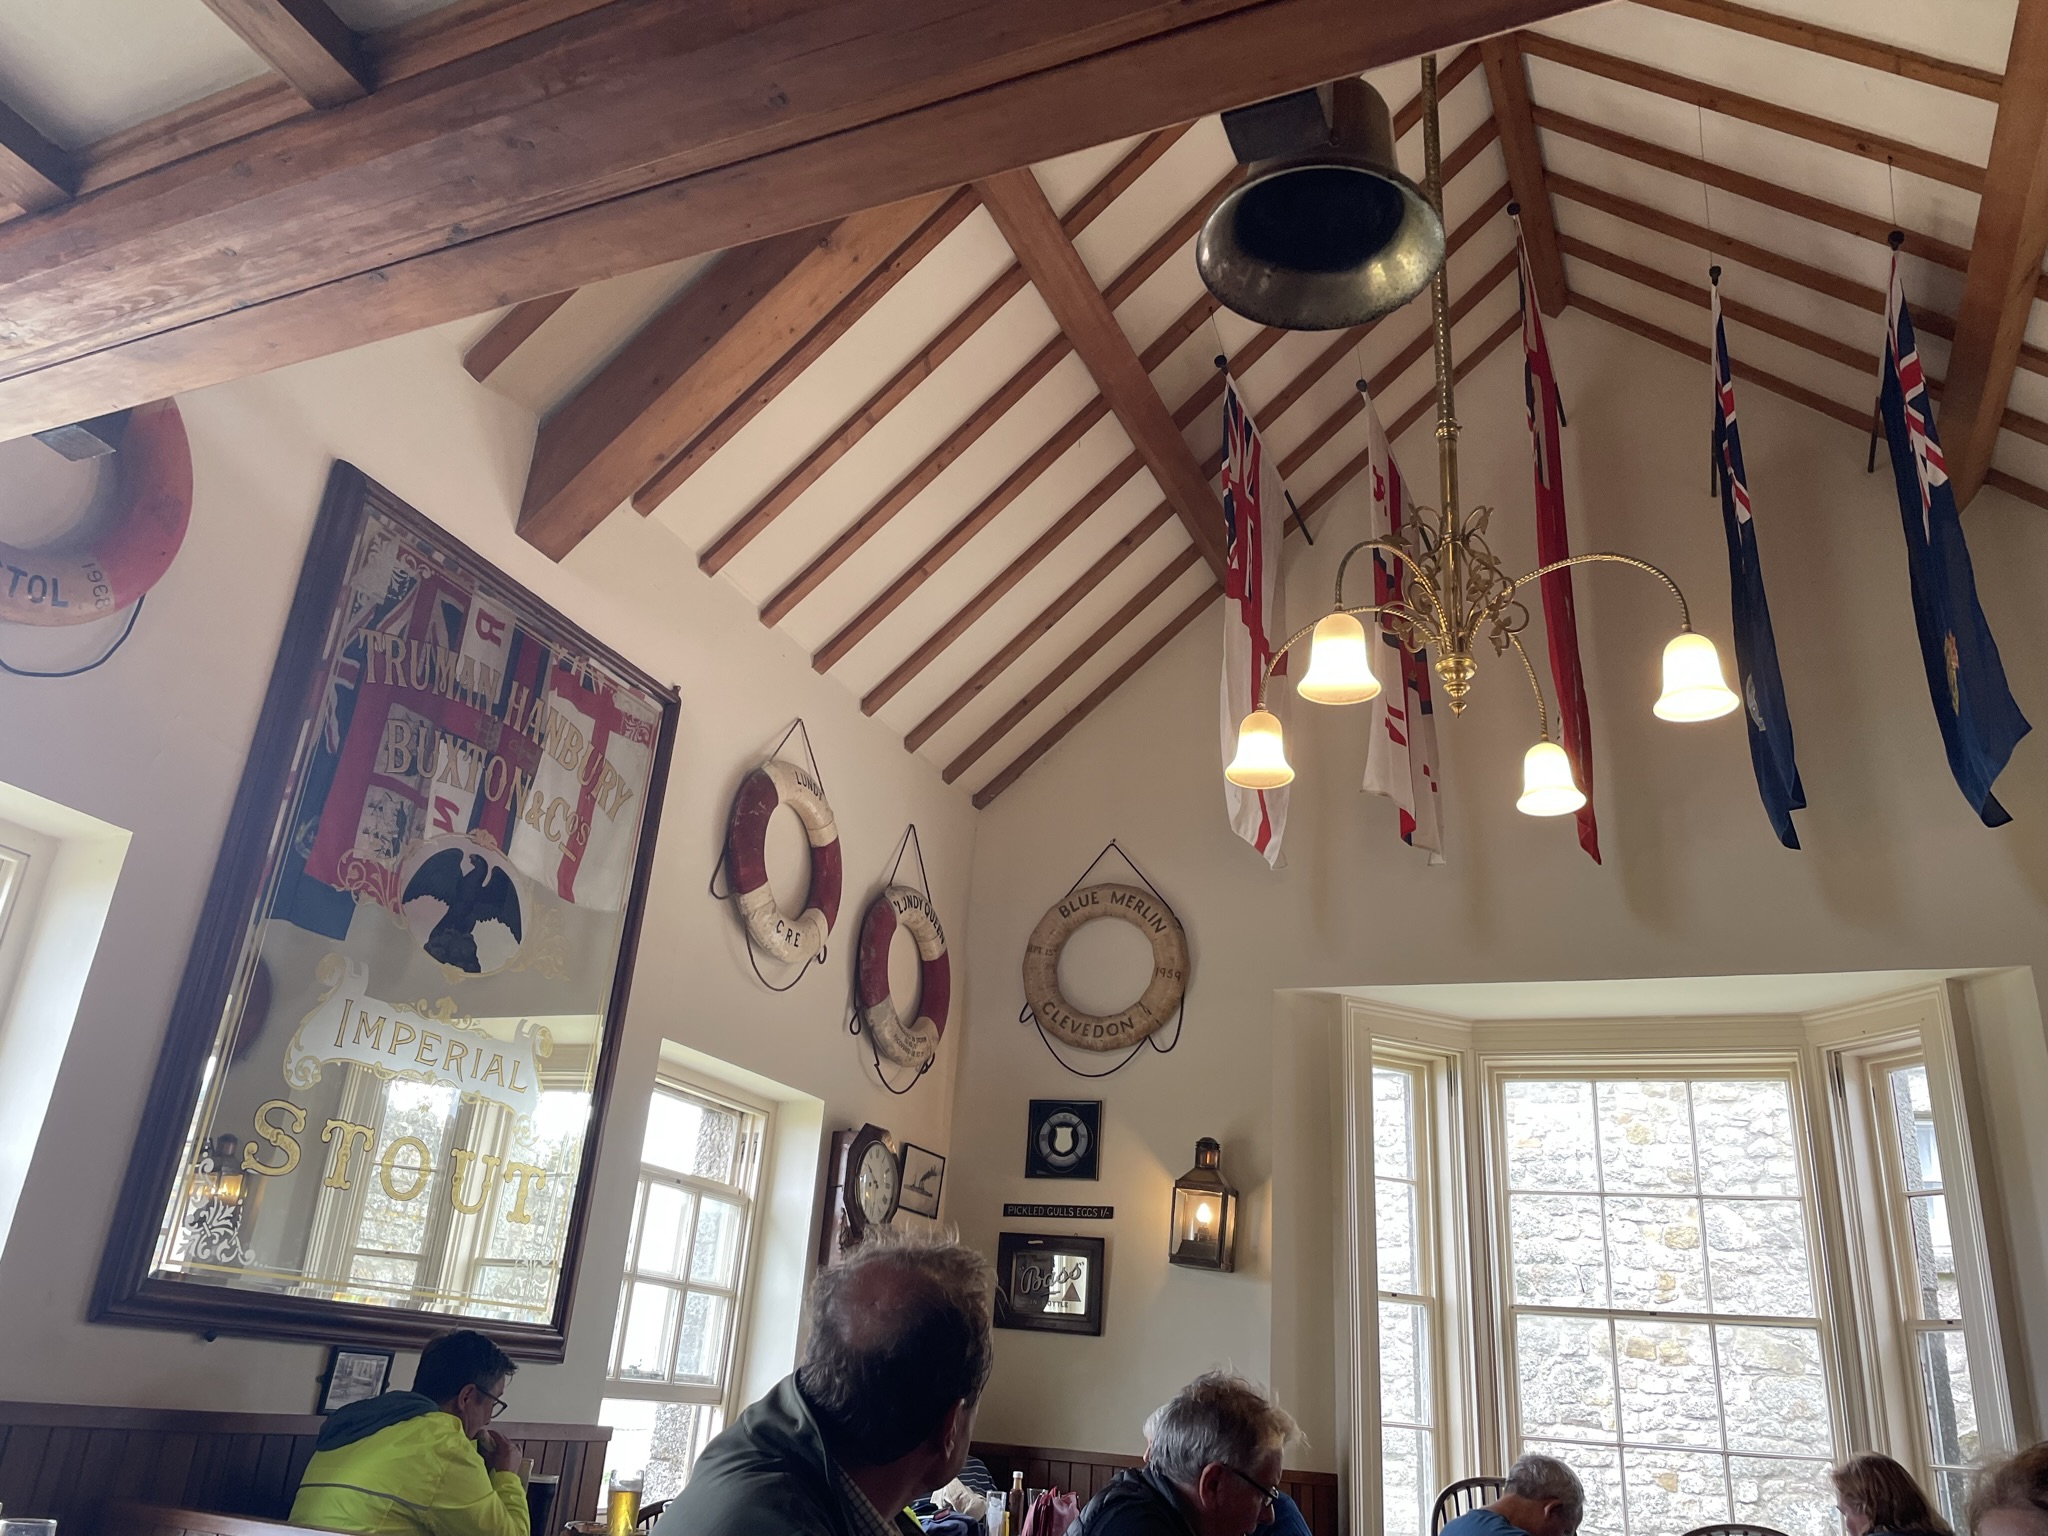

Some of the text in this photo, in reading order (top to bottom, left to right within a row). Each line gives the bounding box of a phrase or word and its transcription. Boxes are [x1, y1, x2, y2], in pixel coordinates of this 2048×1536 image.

[0, 561, 69, 608] TOL
[81, 562, 111, 609] 1968
[384, 718, 533, 820] BUXTON
[503, 679, 634, 823] HANBURY
[794, 770, 823, 801] LUNDY
[1058, 890, 1167, 934] BLUE MERLIN
[1155, 967, 1182, 981] 1959
[1042, 1001, 1135, 1039] CLEVEDON
[334, 998, 528, 1094] IMPERIAL
[241, 1098, 546, 1225] STOUT
[1007, 1205, 1045, 1216] PICKLED
[1046, 1206, 1074, 1217] GULLS
[1076, 1207, 1098, 1218] EGGS
